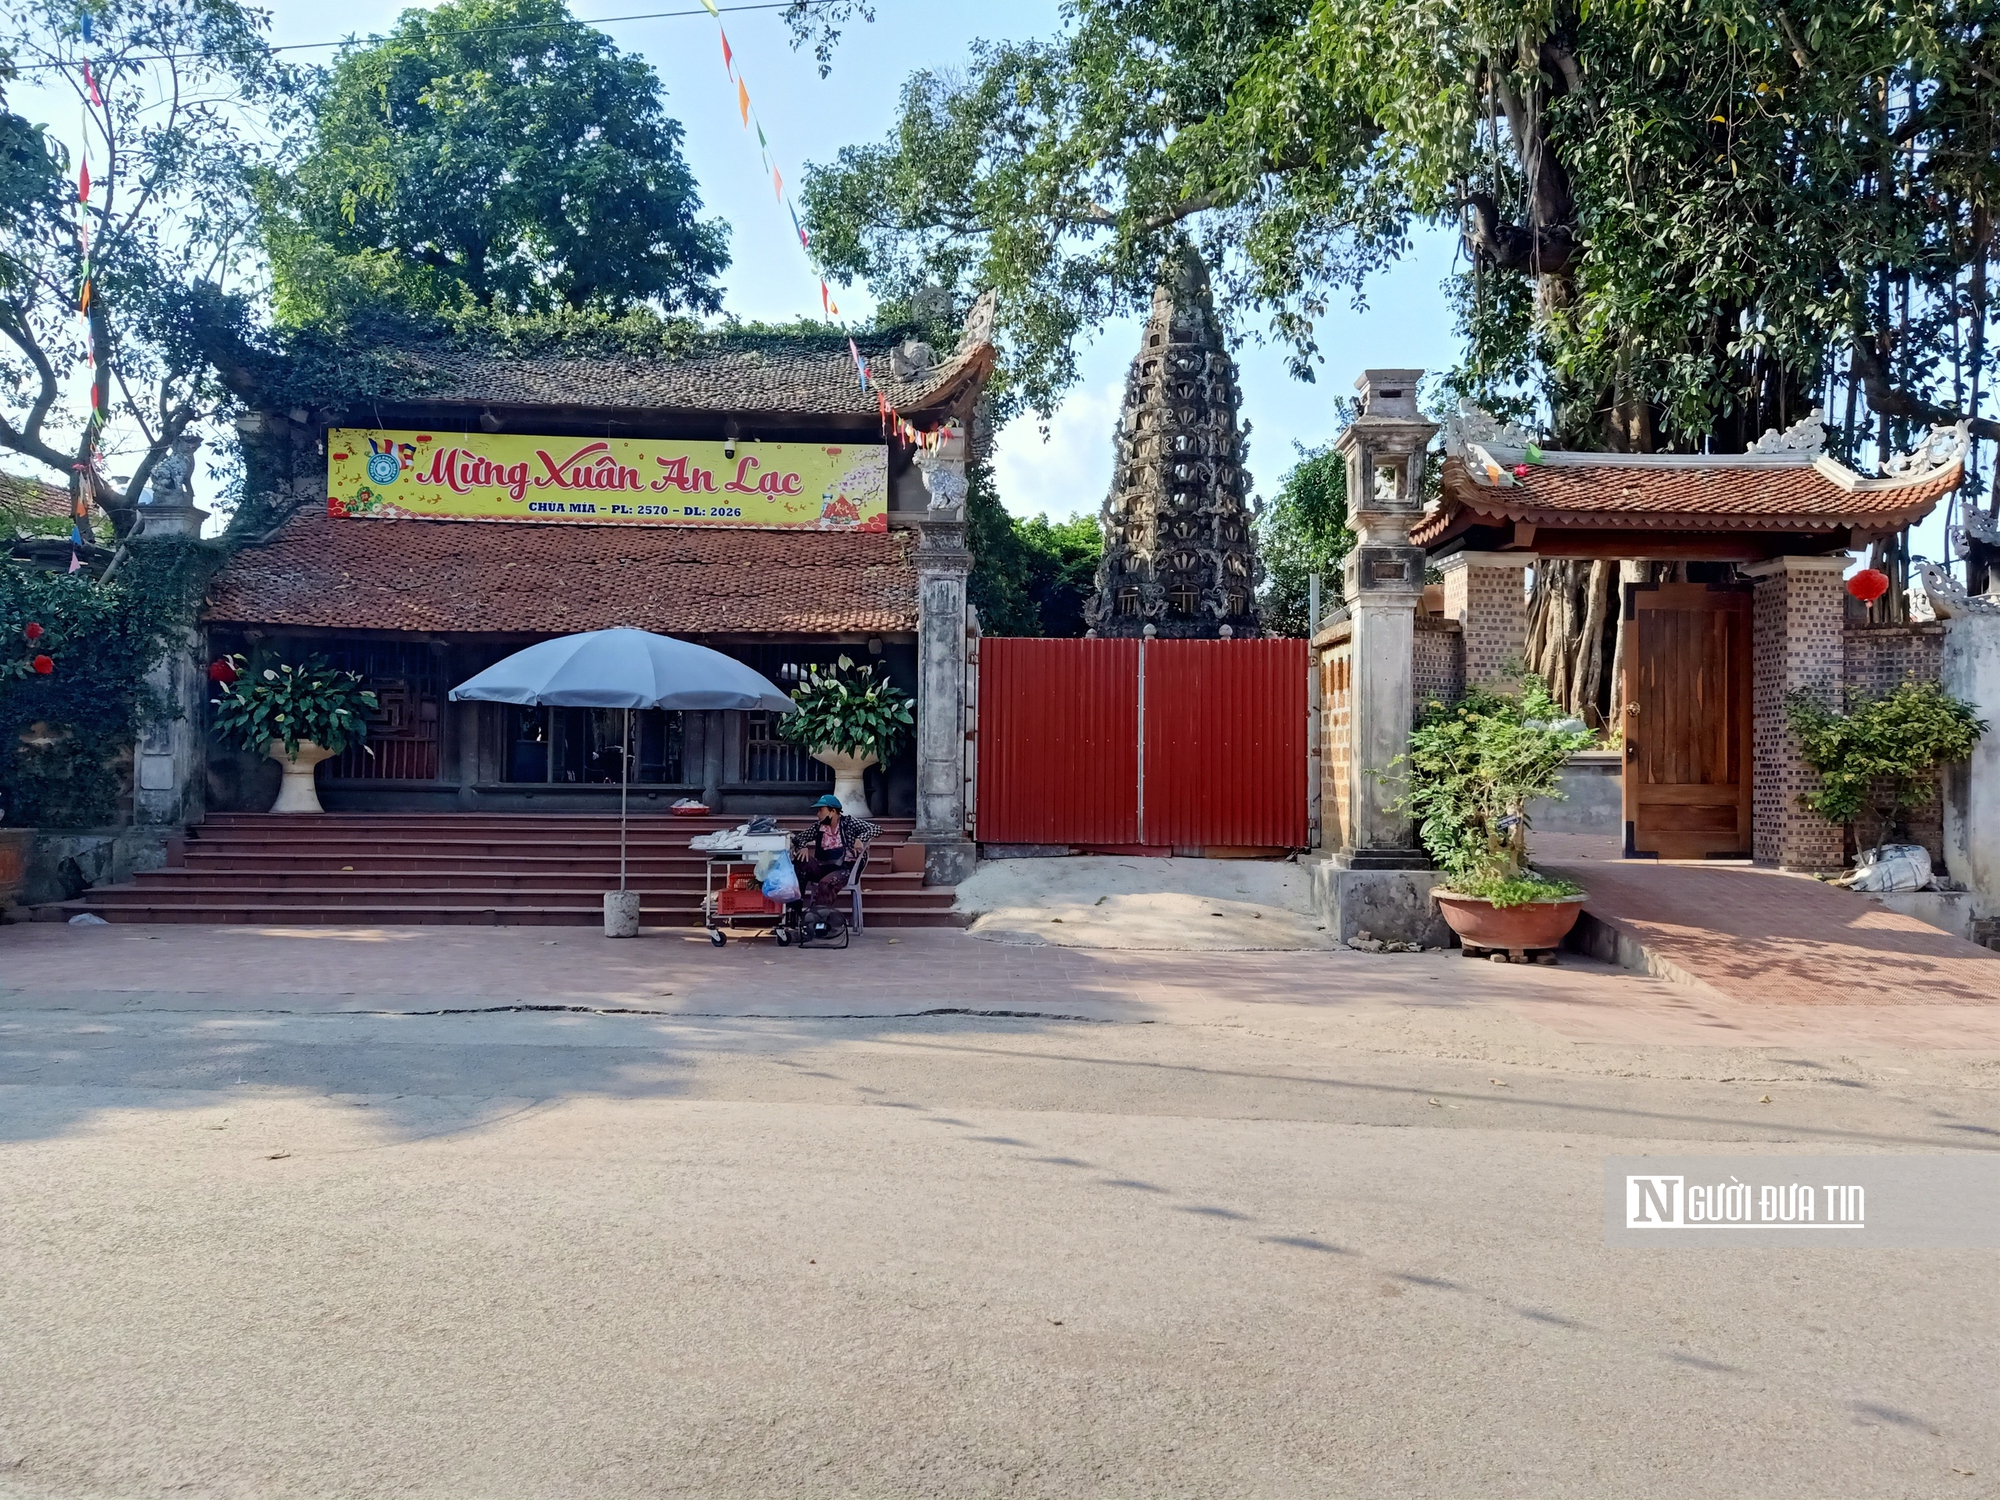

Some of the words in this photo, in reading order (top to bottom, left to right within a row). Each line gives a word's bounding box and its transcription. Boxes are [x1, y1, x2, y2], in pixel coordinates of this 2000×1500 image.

[414, 447, 531, 501] Mừng
[534, 442, 645, 491] Xuân
[651, 455, 719, 492] An
[724, 456, 803, 502] Lạc
[528, 501, 566, 513] CHÙA
[569, 501, 596, 514] MÍA
[611, 504, 633, 515] PL:
[637, 505, 669, 516] 2570
[683, 506, 706, 517] DL:
[710, 506, 742, 517] 2026
